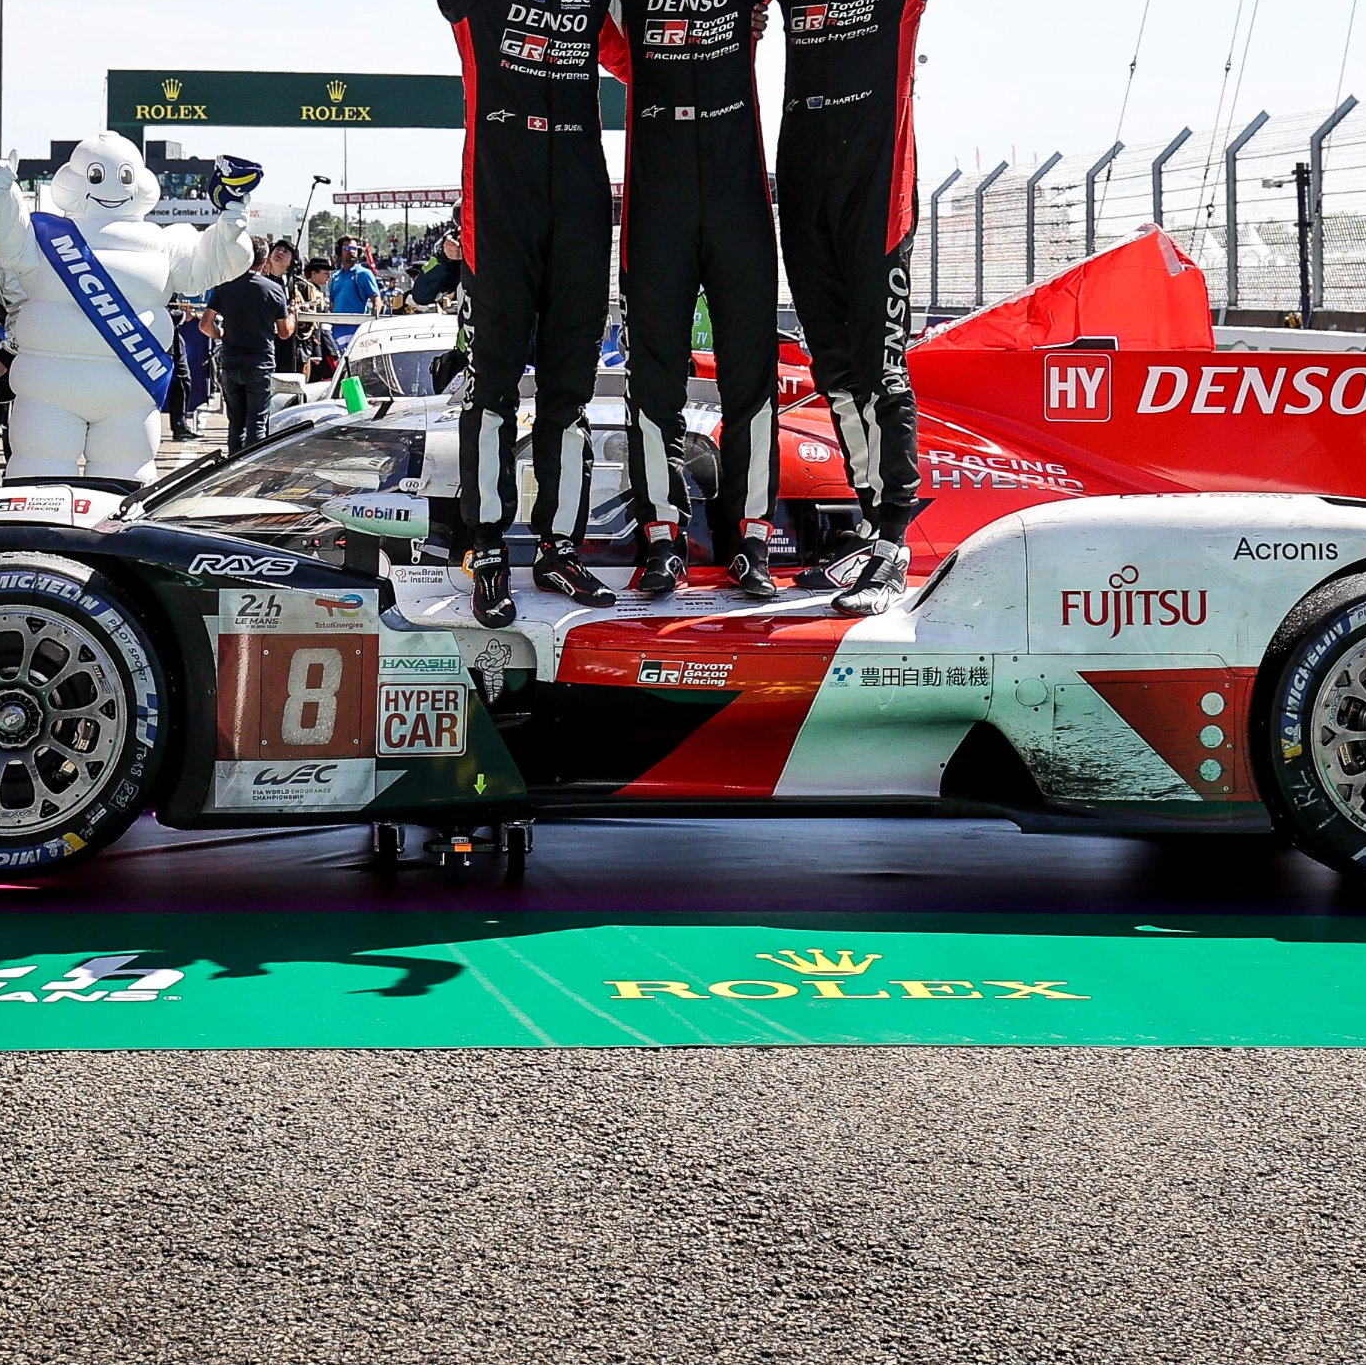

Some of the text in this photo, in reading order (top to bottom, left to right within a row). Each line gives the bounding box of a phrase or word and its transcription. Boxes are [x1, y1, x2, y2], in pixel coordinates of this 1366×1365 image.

[507, 3, 588, 33] DENSO
[694, 11, 739, 29] TOYOTA
[828, 4, 874, 18] GAZOO
[692, 21, 734, 37] GAZOO
[792, 14, 824, 30] GR
[646, 29, 685, 44] GR
[828, 24, 878, 41] HYBRID
[503, 39, 543, 60] GR
[550, 49, 590, 57] GAZOO
[552, 40, 591, 49] TOYOTA
[695, 42, 739, 61] HYBRID
[136, 105, 208, 120] ROLEX
[301, 106, 372, 121] ROLEX
[171, 207, 199, 216] Center
[51, 234, 167, 382] MICHELIN
[1050, 367, 1105, 409] HY
[928, 449, 1067, 476] RACING
[931, 470, 1084, 492] HYBRID
[352, 505, 392, 519] Mobil
[1233, 537, 1339, 561] Acronis
[188, 554, 298, 575] RAYS
[421, 568, 443, 577] Brain
[410, 576, 443, 584] Institute
[236, 594, 282, 617] 24h
[1061, 590, 1208, 639] FUJITSU
[315, 621, 363, 630] TotalEnergies
[382, 659, 457, 669] HAYASHI
[1286, 623, 1344, 717] MICHELIN
[640, 669, 680, 683] GR
[682, 677, 726, 687] Racing
[859, 666, 989, 688] 豊田自動織機
[281, 647, 343, 746] 8
[385, 689, 459, 712] HYPER
[384, 712, 459, 749] CAR
[252, 764, 339, 785] WEC
[608, 977, 1092, 1002] ROLEX
